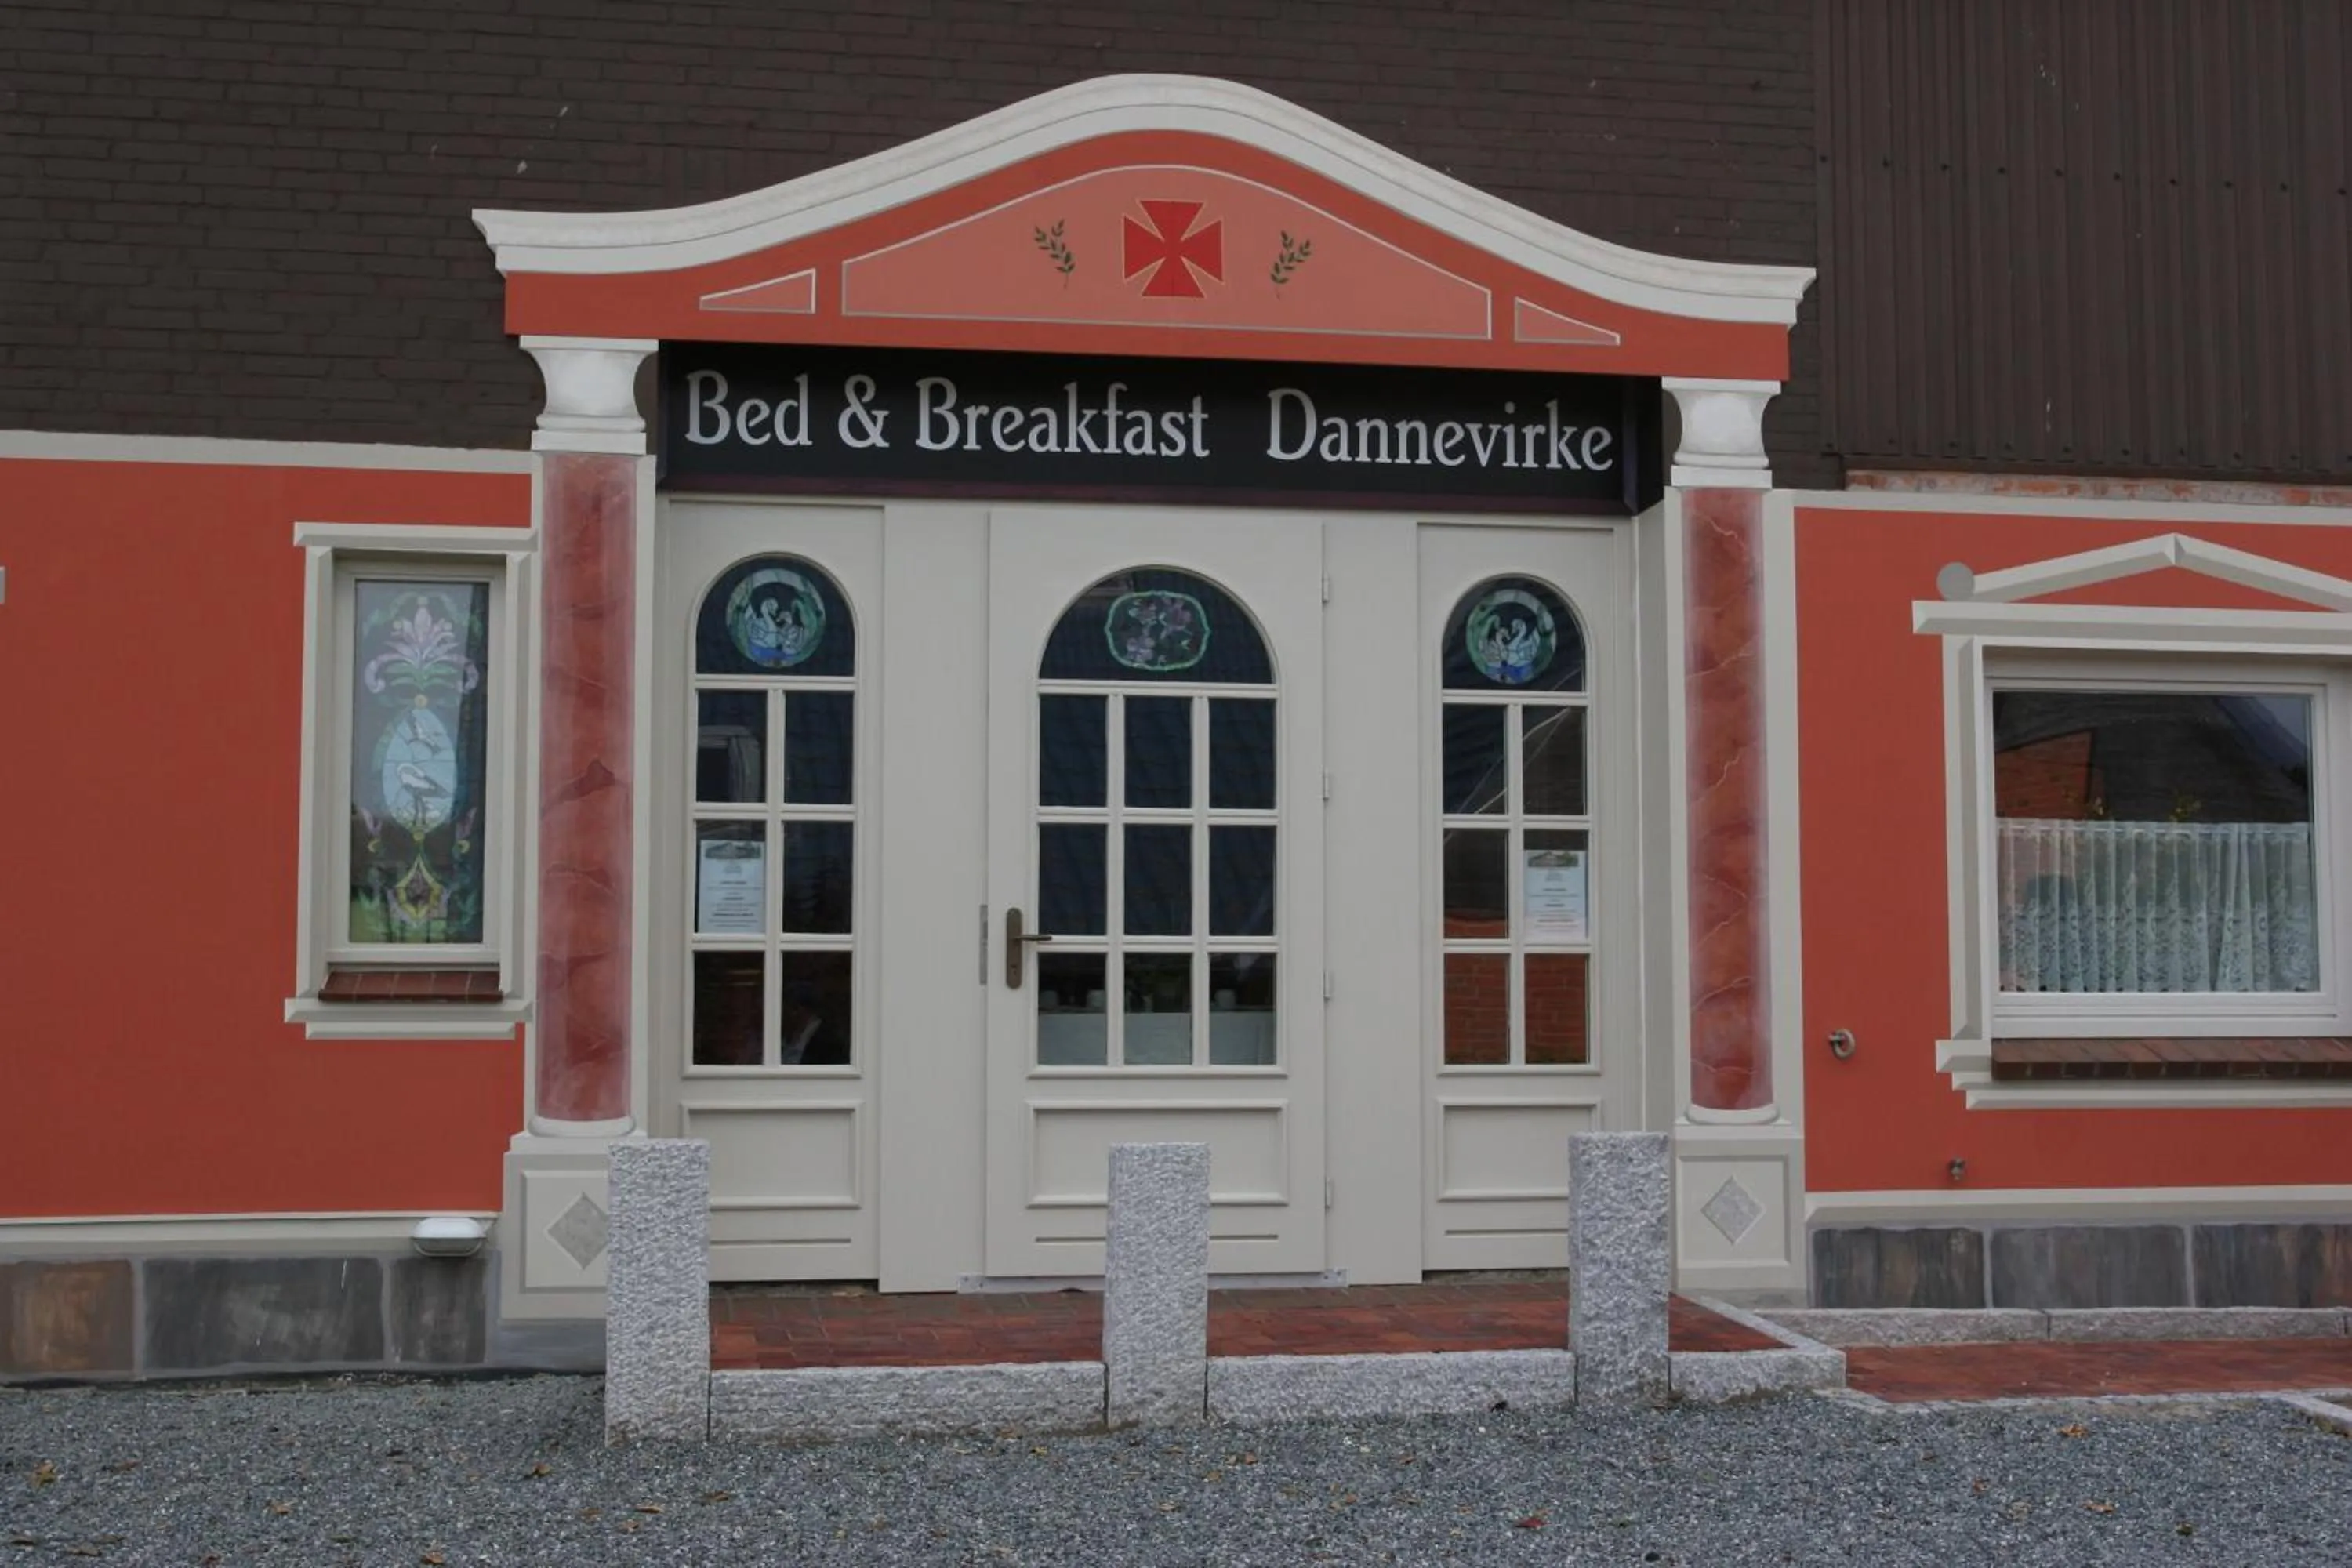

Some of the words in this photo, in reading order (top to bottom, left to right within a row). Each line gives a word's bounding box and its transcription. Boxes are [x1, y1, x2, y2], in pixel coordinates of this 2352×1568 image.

[684, 369, 813, 446] Bed
[837, 374, 891, 450] &
[915, 376, 1210, 457] Breakfast
[1266, 388, 1613, 471] Dannevirke
